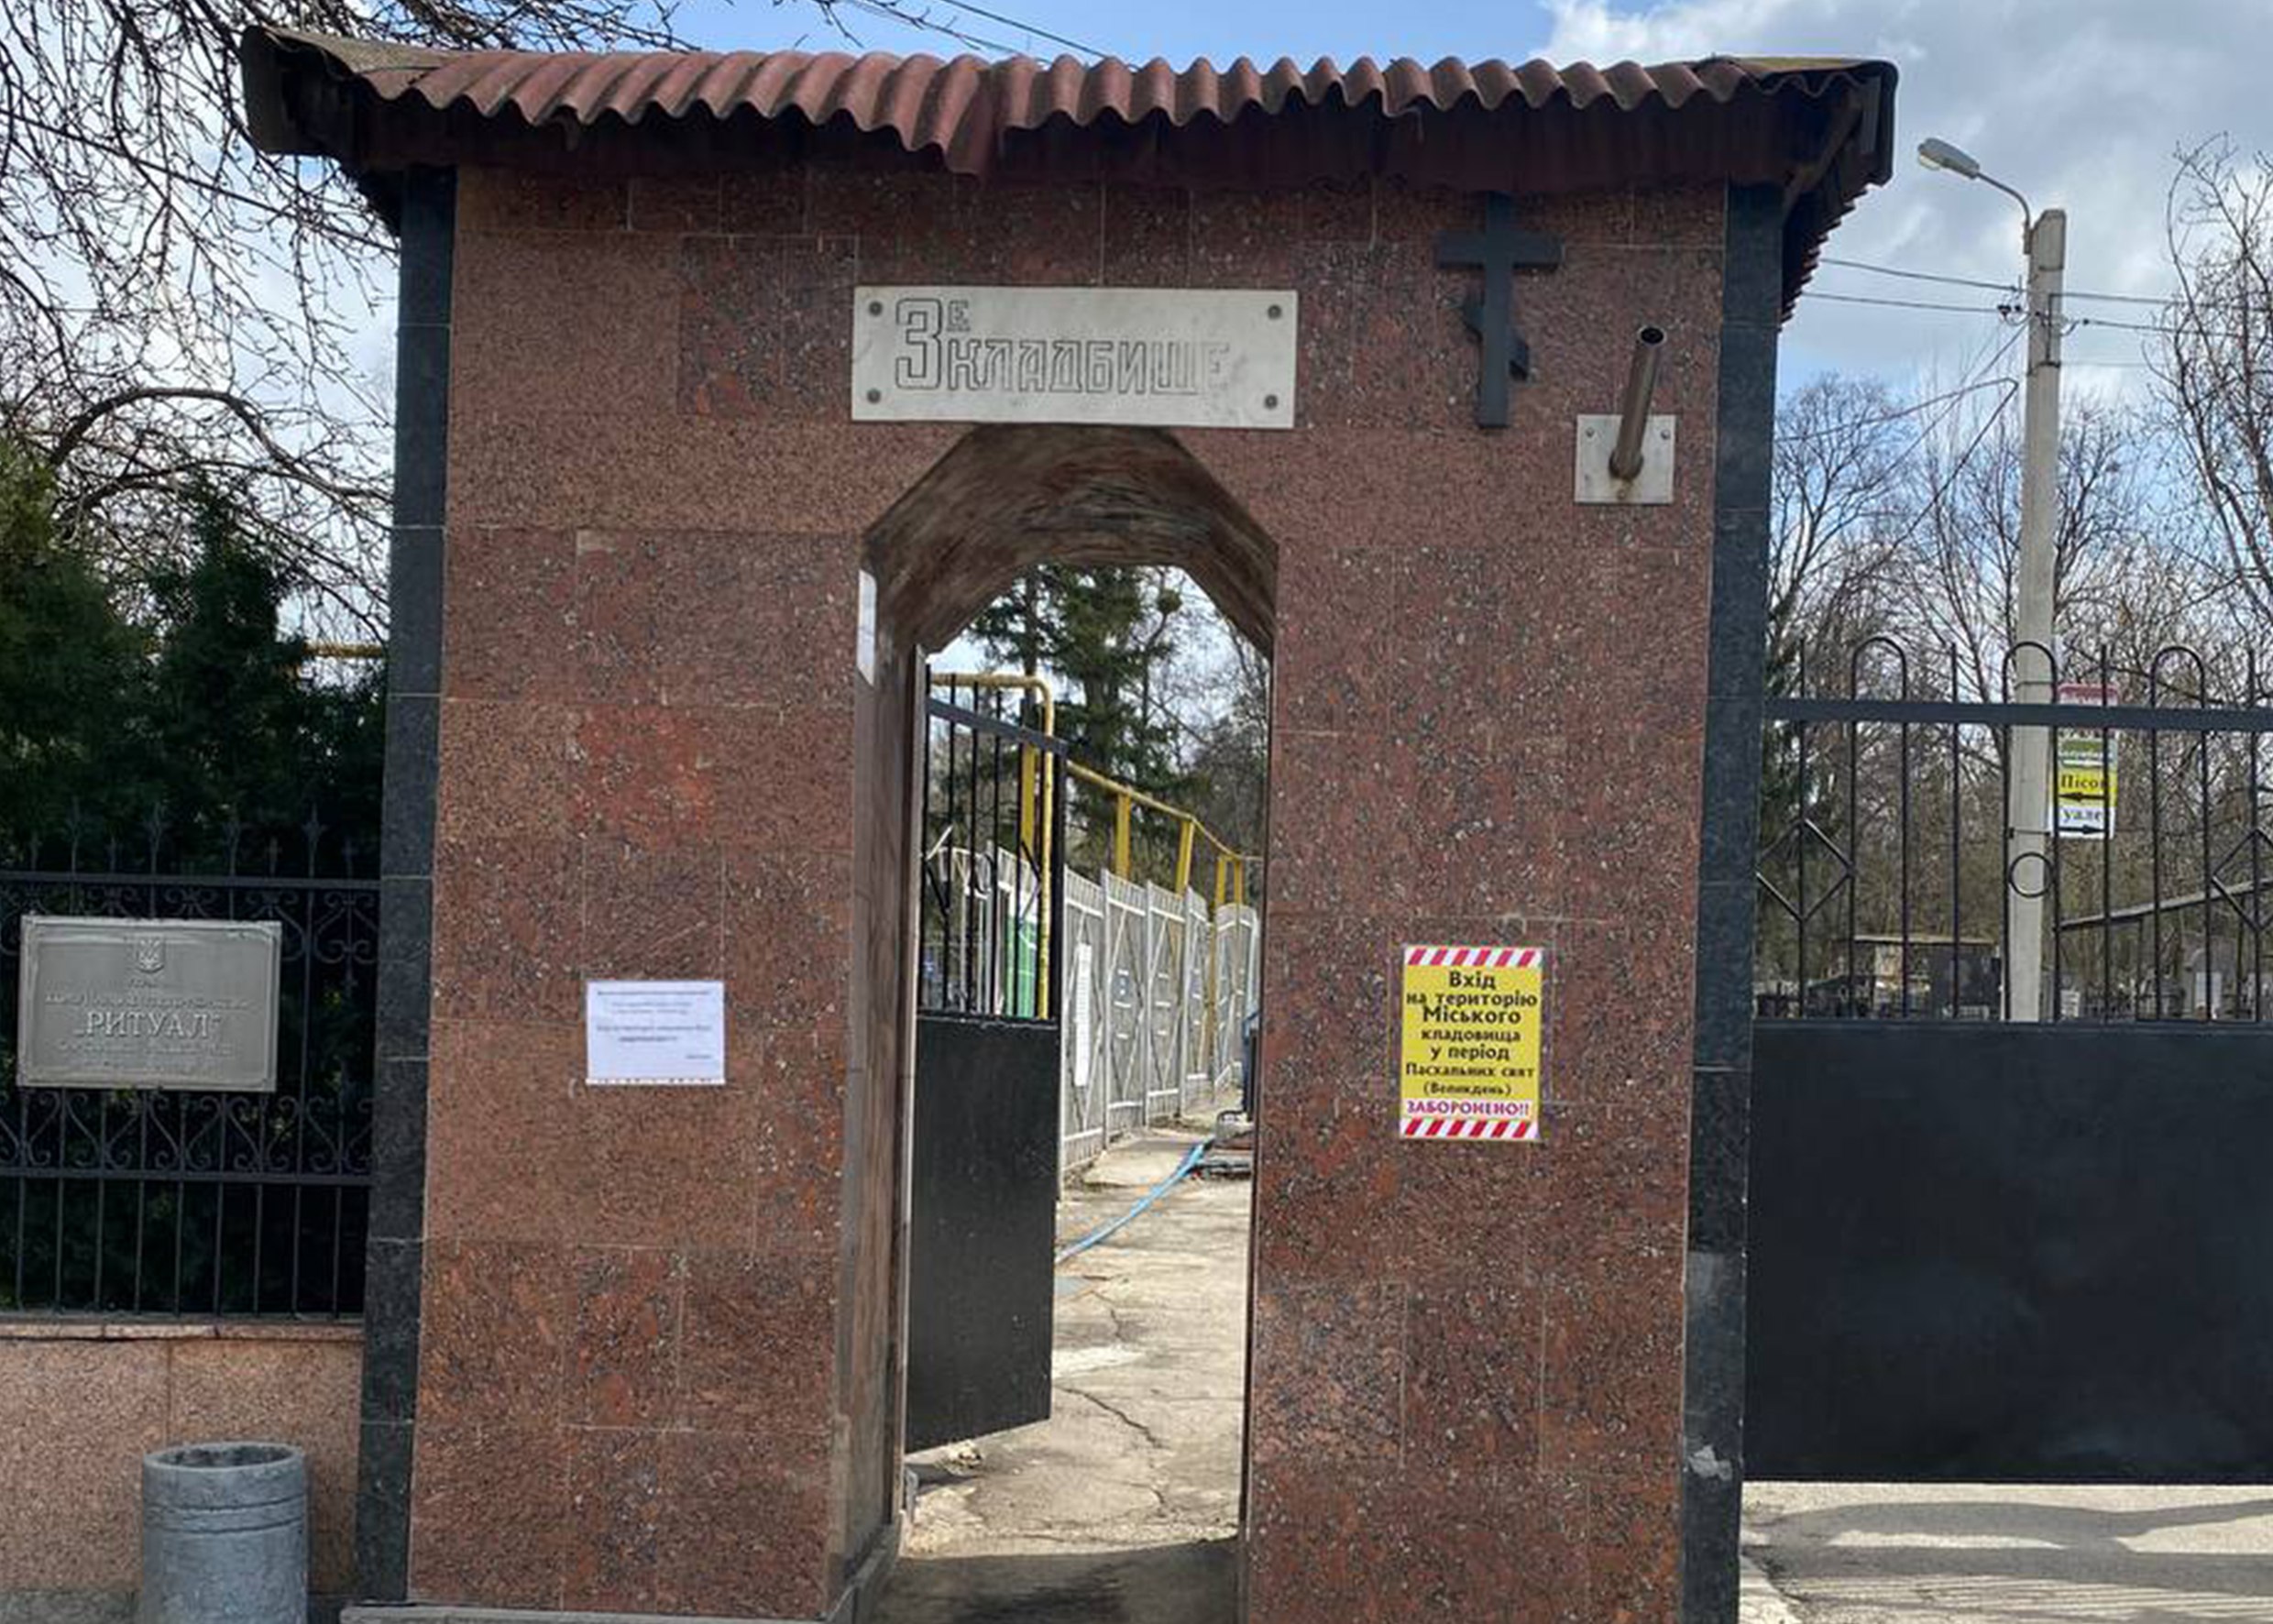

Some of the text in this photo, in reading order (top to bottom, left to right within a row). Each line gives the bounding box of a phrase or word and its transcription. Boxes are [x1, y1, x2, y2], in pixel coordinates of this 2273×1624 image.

[2061, 774, 2107, 788] Пісо
[1448, 971, 1497, 990] Вхід
[1406, 990, 1538, 1007] на територію
[1422, 1005, 1521, 1025] Міського
[1421, 1029, 1521, 1043] кладовища
[1447, 1043, 1510, 1060] період
[1405, 1062, 1535, 1079] Пасхальних свят
